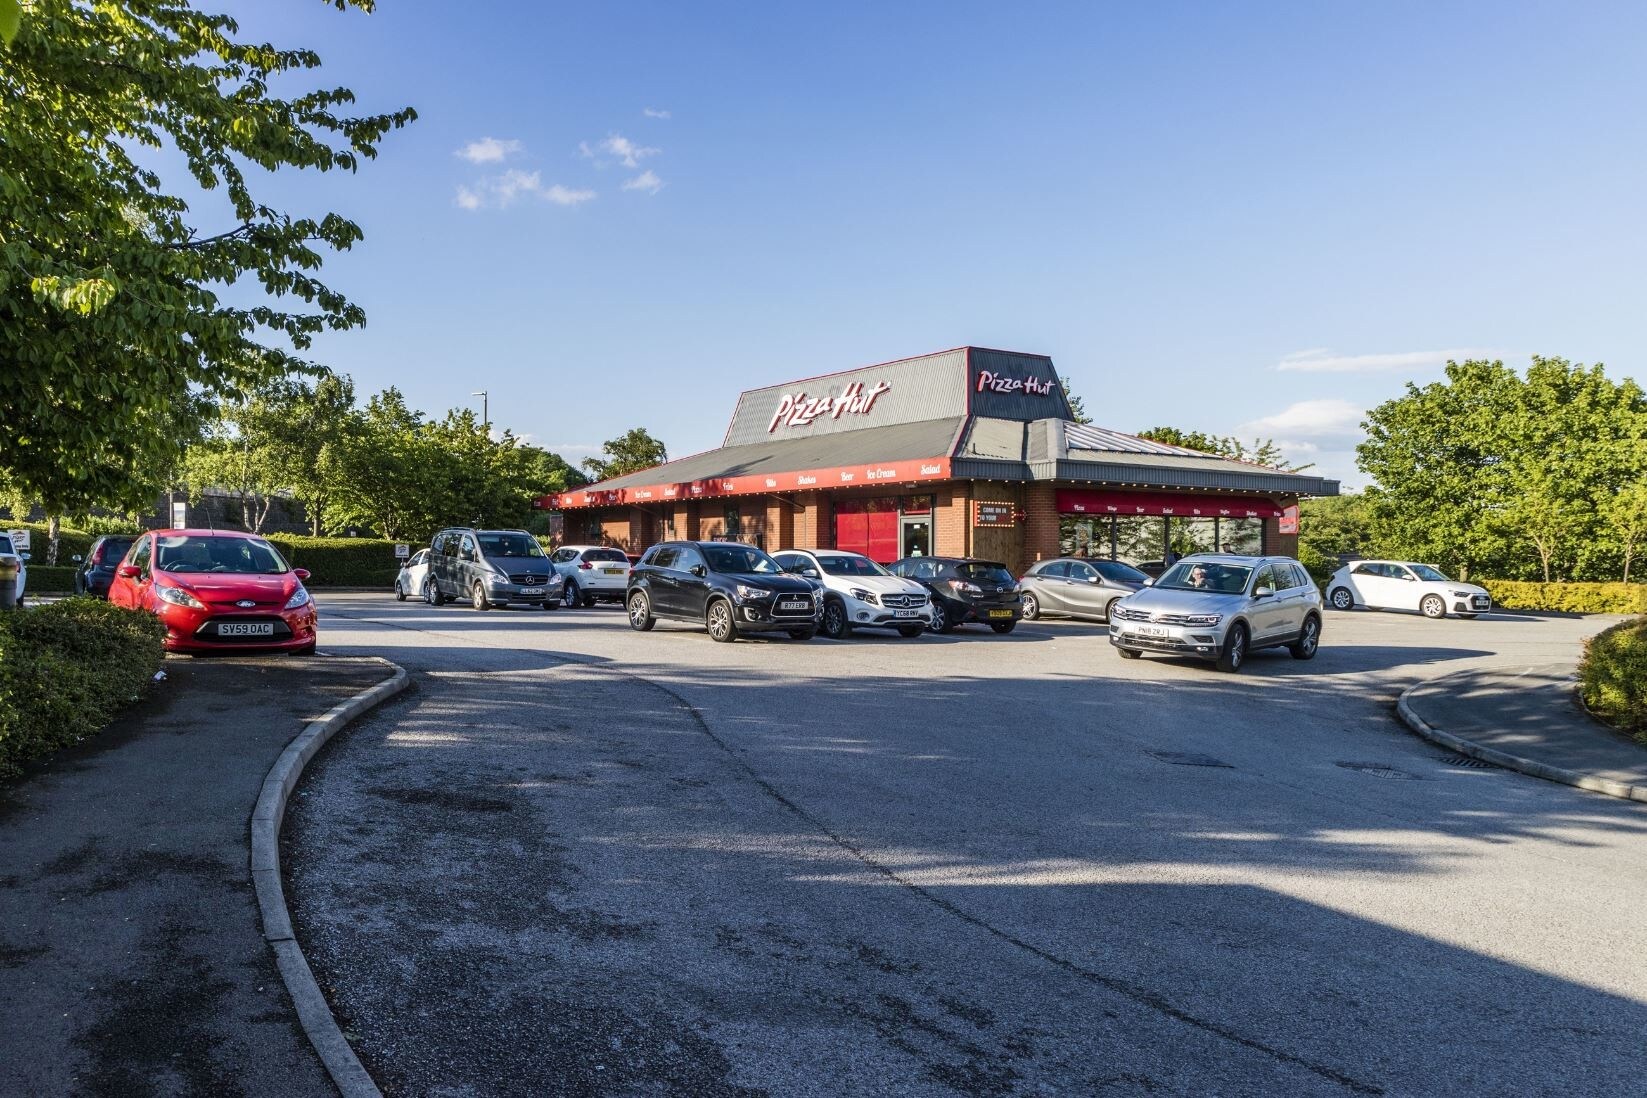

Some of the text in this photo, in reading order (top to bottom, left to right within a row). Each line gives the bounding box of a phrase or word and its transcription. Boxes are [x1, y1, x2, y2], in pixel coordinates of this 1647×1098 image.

[976, 370, 1056, 396] Pizza Hut
[768, 380, 893, 433] Pizza Hut
[866, 468, 896, 480] Ice Cream
[920, 464, 941, 475] Salad
[797, 475, 817, 486] Shakes
[840, 471, 854, 482] Beer
[222, 624, 269, 634] SV59 OAC
